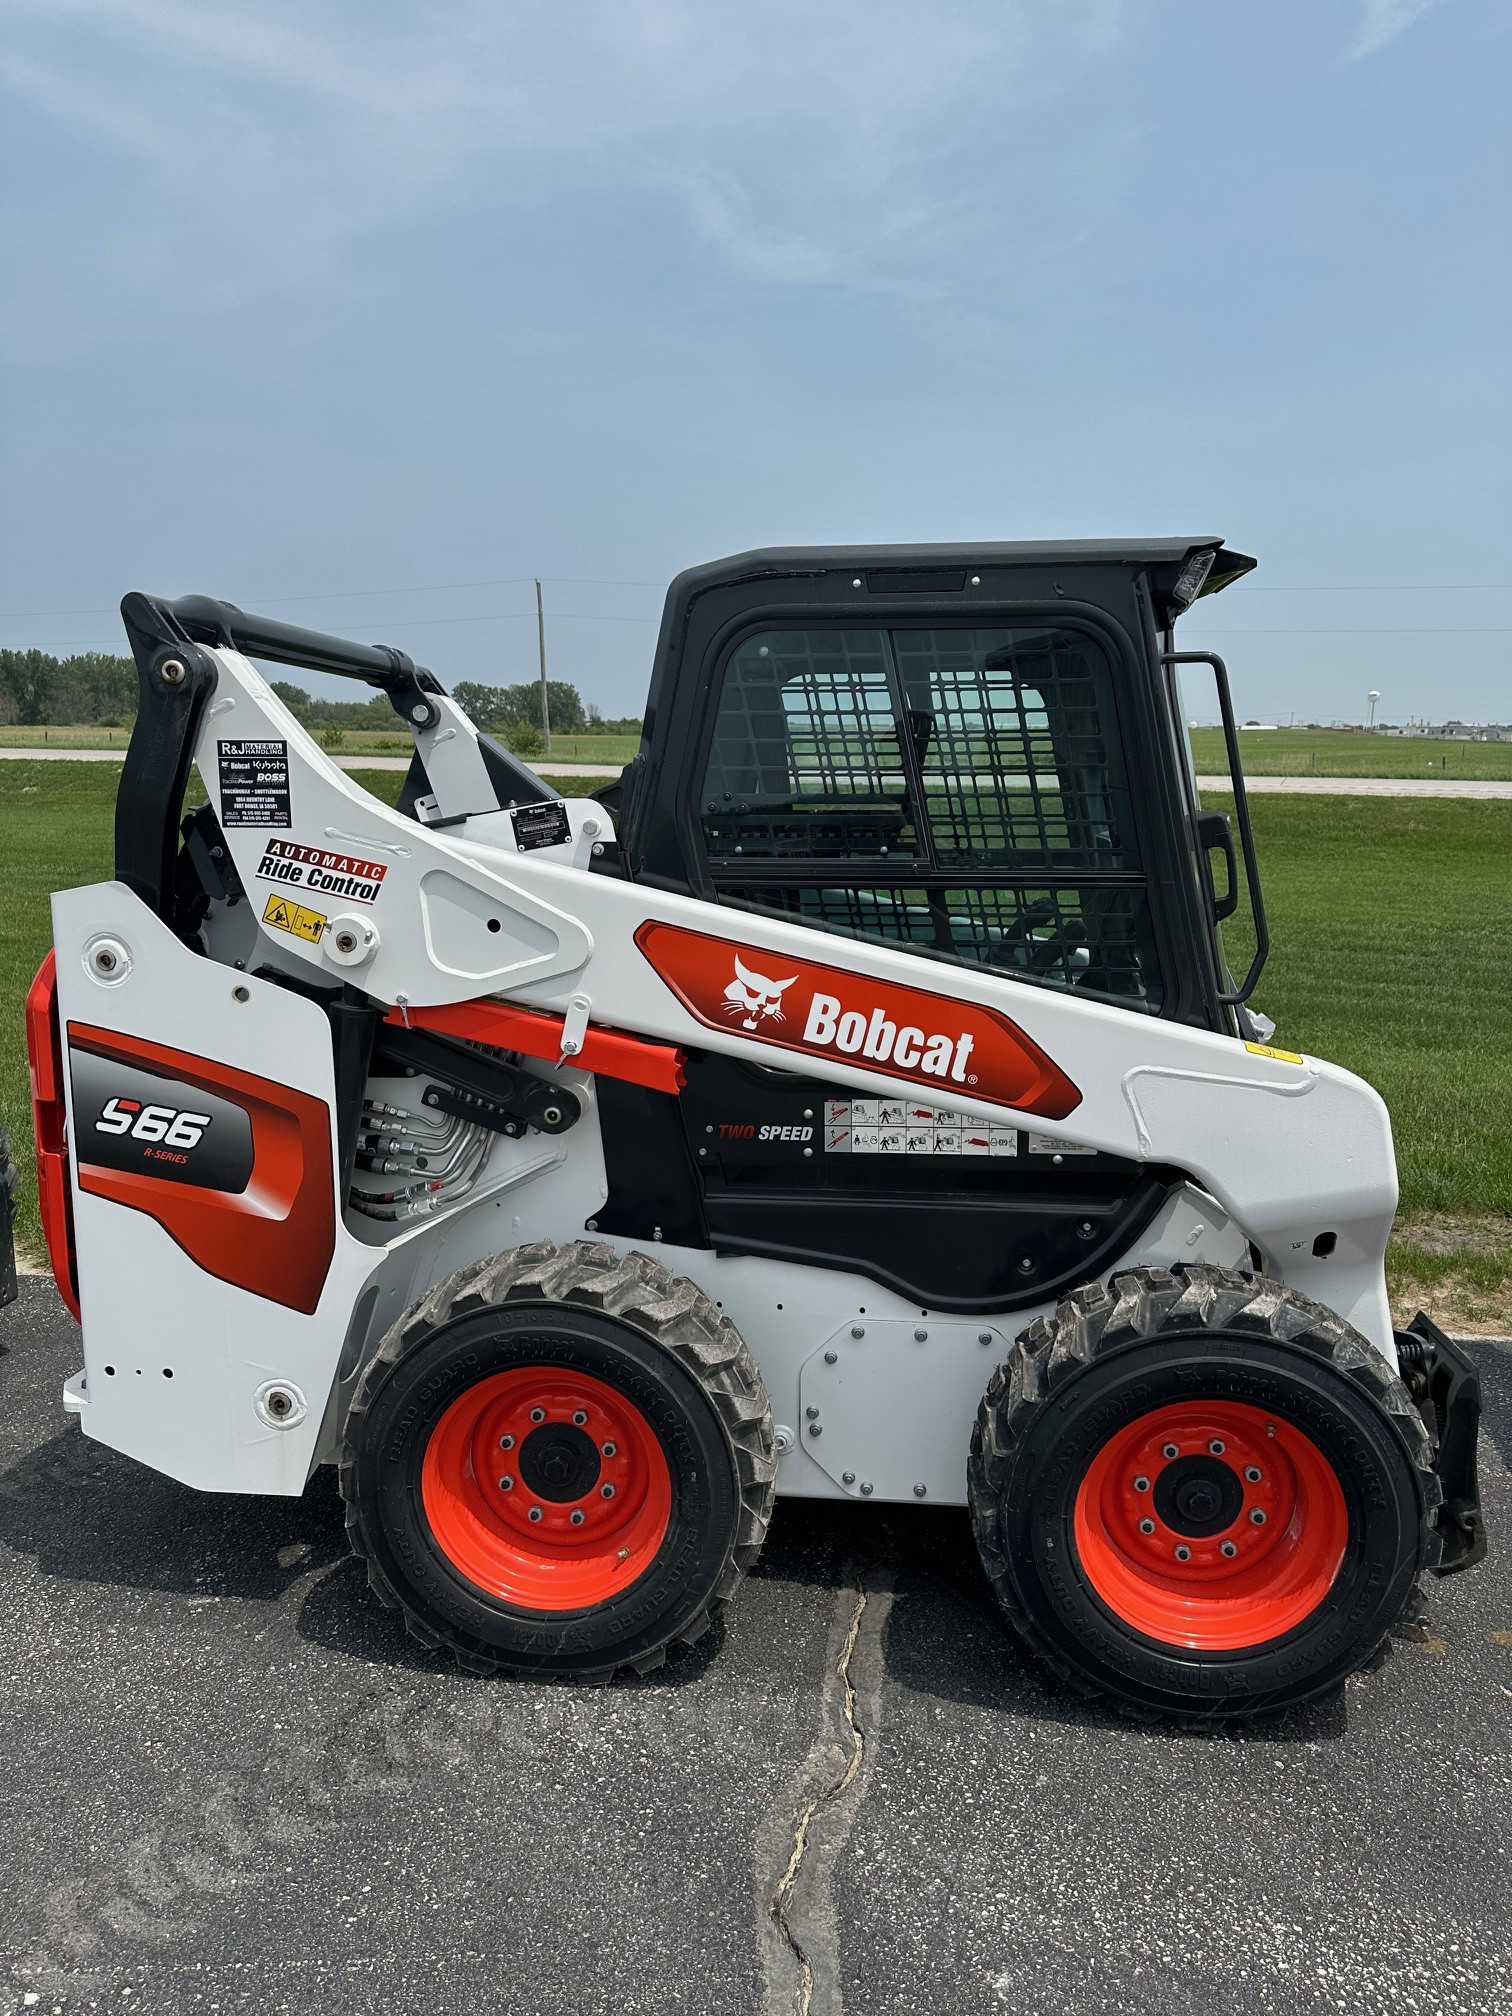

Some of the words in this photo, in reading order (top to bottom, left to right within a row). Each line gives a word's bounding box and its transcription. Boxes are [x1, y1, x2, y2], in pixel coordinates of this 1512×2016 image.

[222, 742, 245, 755] R&J
[230, 762, 251, 770] Bobcat
[252, 760, 286, 770] Kubota
[257, 772, 287, 781] BOSS
[270, 842, 382, 879] AUTOMATIC
[257, 855, 303, 882] Ride
[306, 867, 381, 902] Control
[803, 992, 974, 1083] Bobcat
[96, 1098, 212, 1150] S66
[719, 1124, 756, 1140] TWO
[758, 1125, 814, 1141] SPEED
[143, 1147, 189, 1165] R-SERIES
[418, 1352, 479, 1401] GUARD
